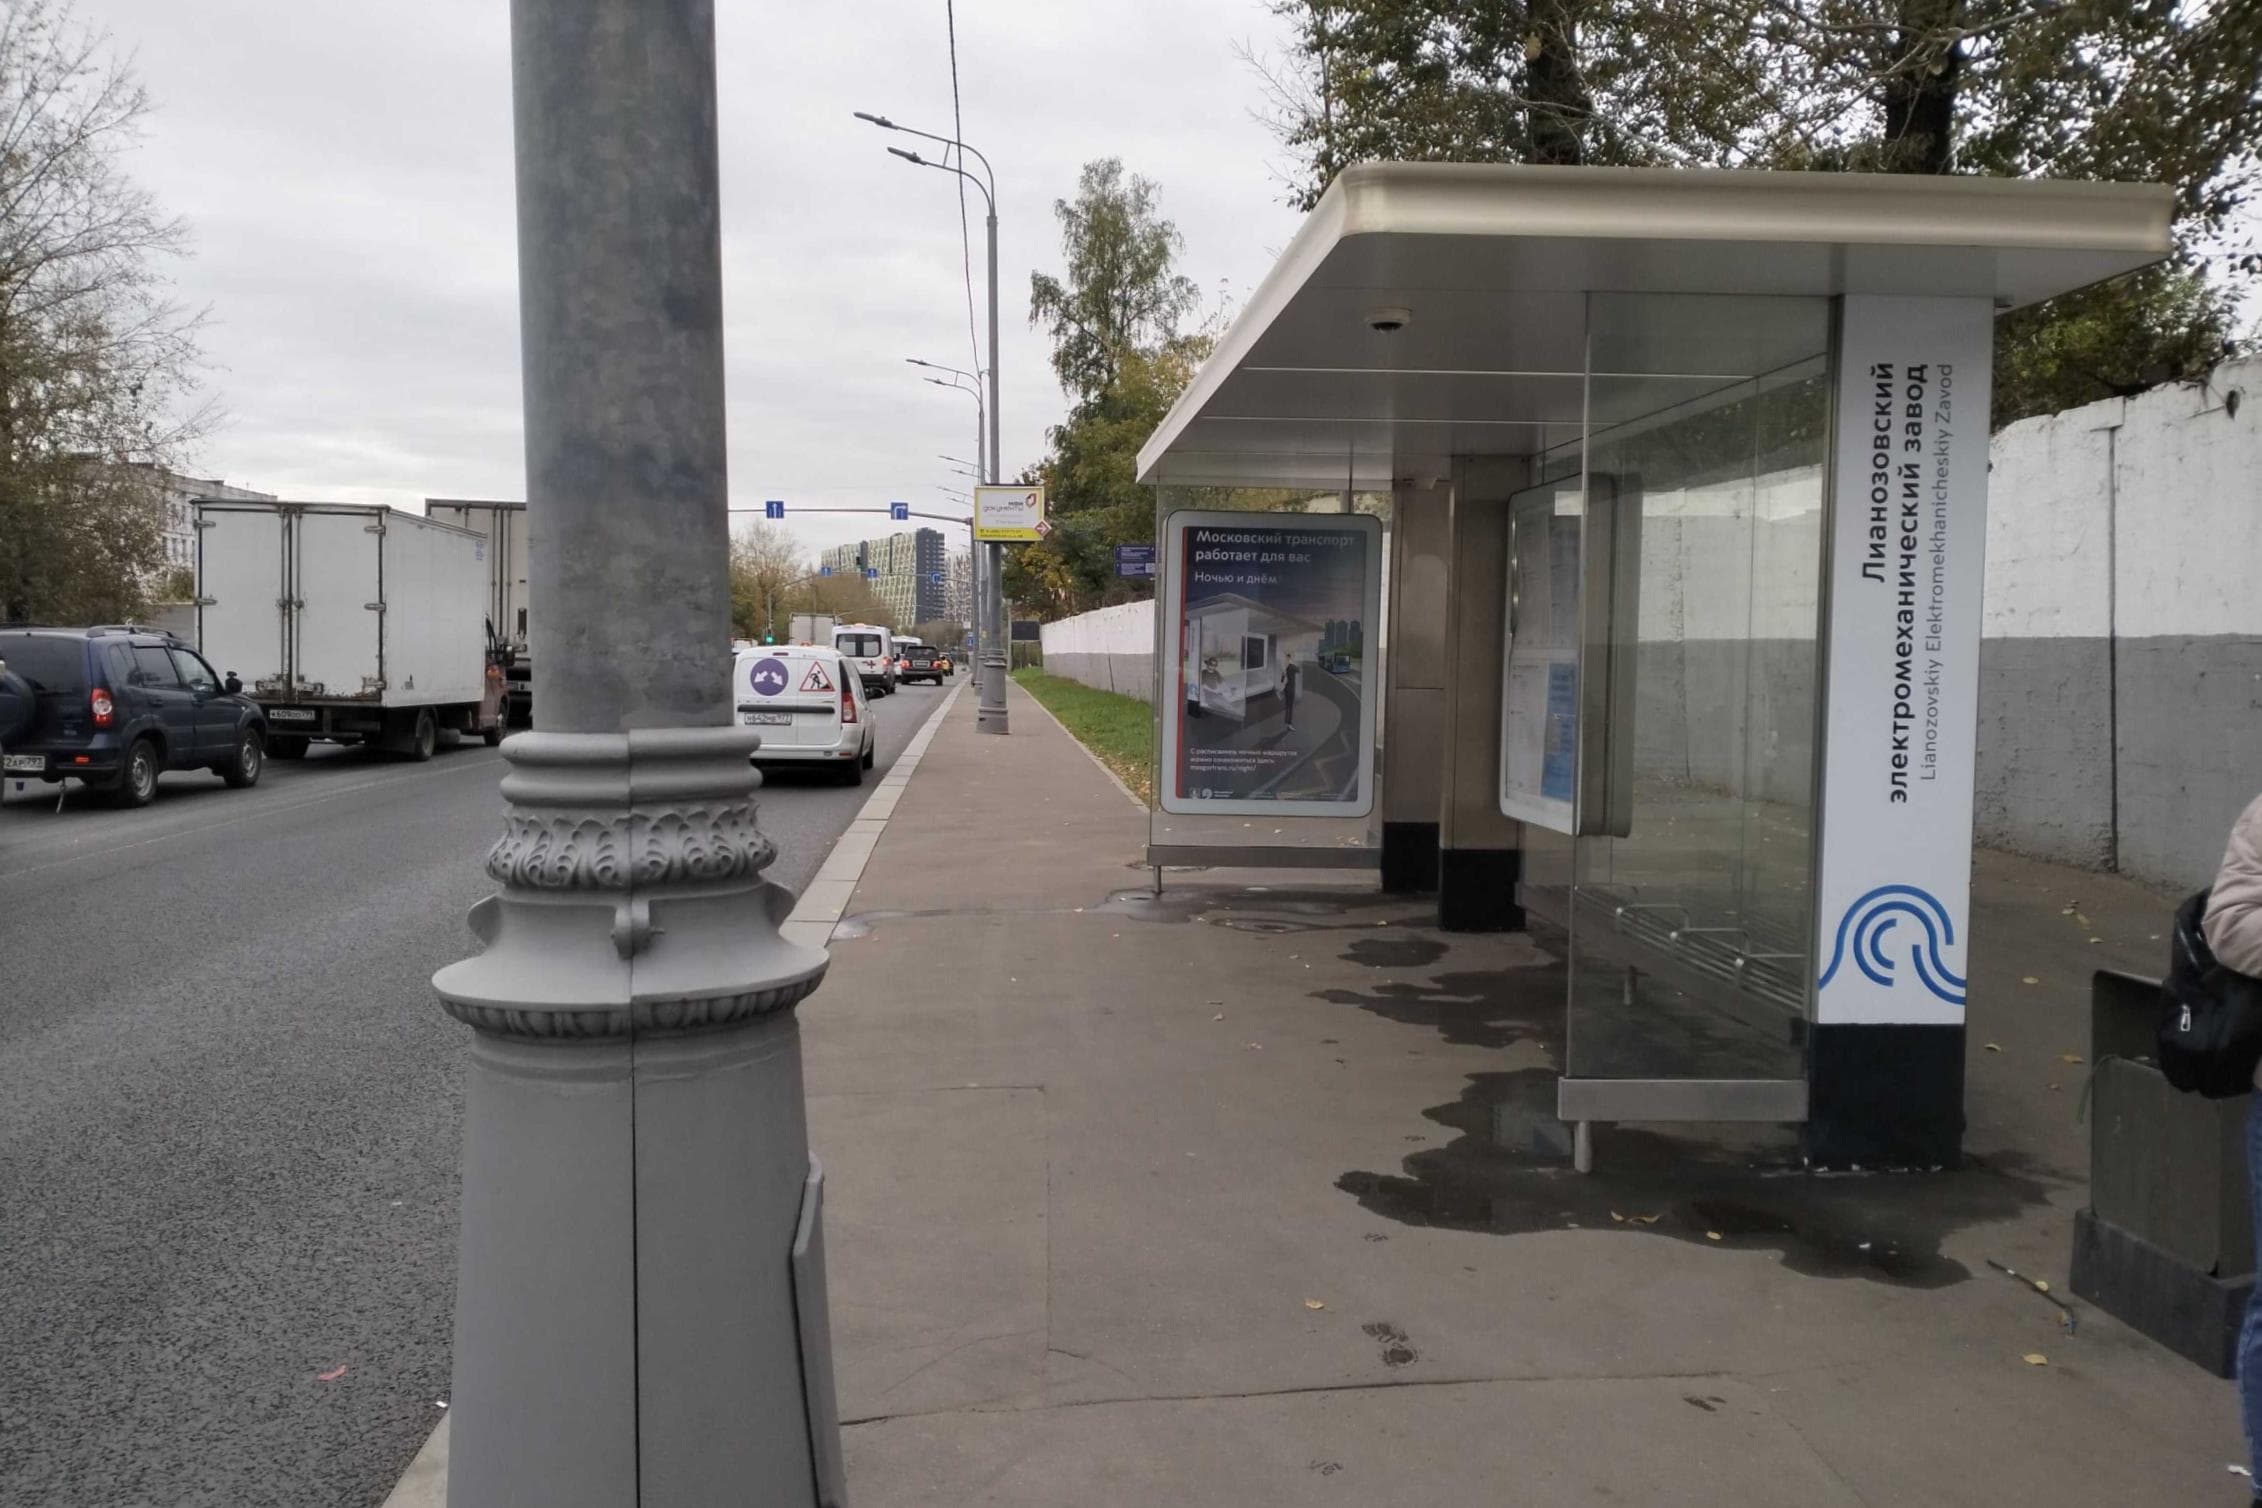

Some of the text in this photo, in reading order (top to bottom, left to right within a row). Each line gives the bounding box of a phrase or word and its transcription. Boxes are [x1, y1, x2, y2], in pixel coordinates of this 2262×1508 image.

[1862, 363, 1894, 583] Лианозовский
[1194, 571, 1278, 585] Ночью и днём
[1195, 548, 1311, 564] работает для вас
[1196, 530, 1355, 549] Московский транспорт
[1890, 364, 1928, 803] электромеханический завод
[1921, 364, 1954, 780] Lianozovskiy Elektromekhanicheskiy Zavod
